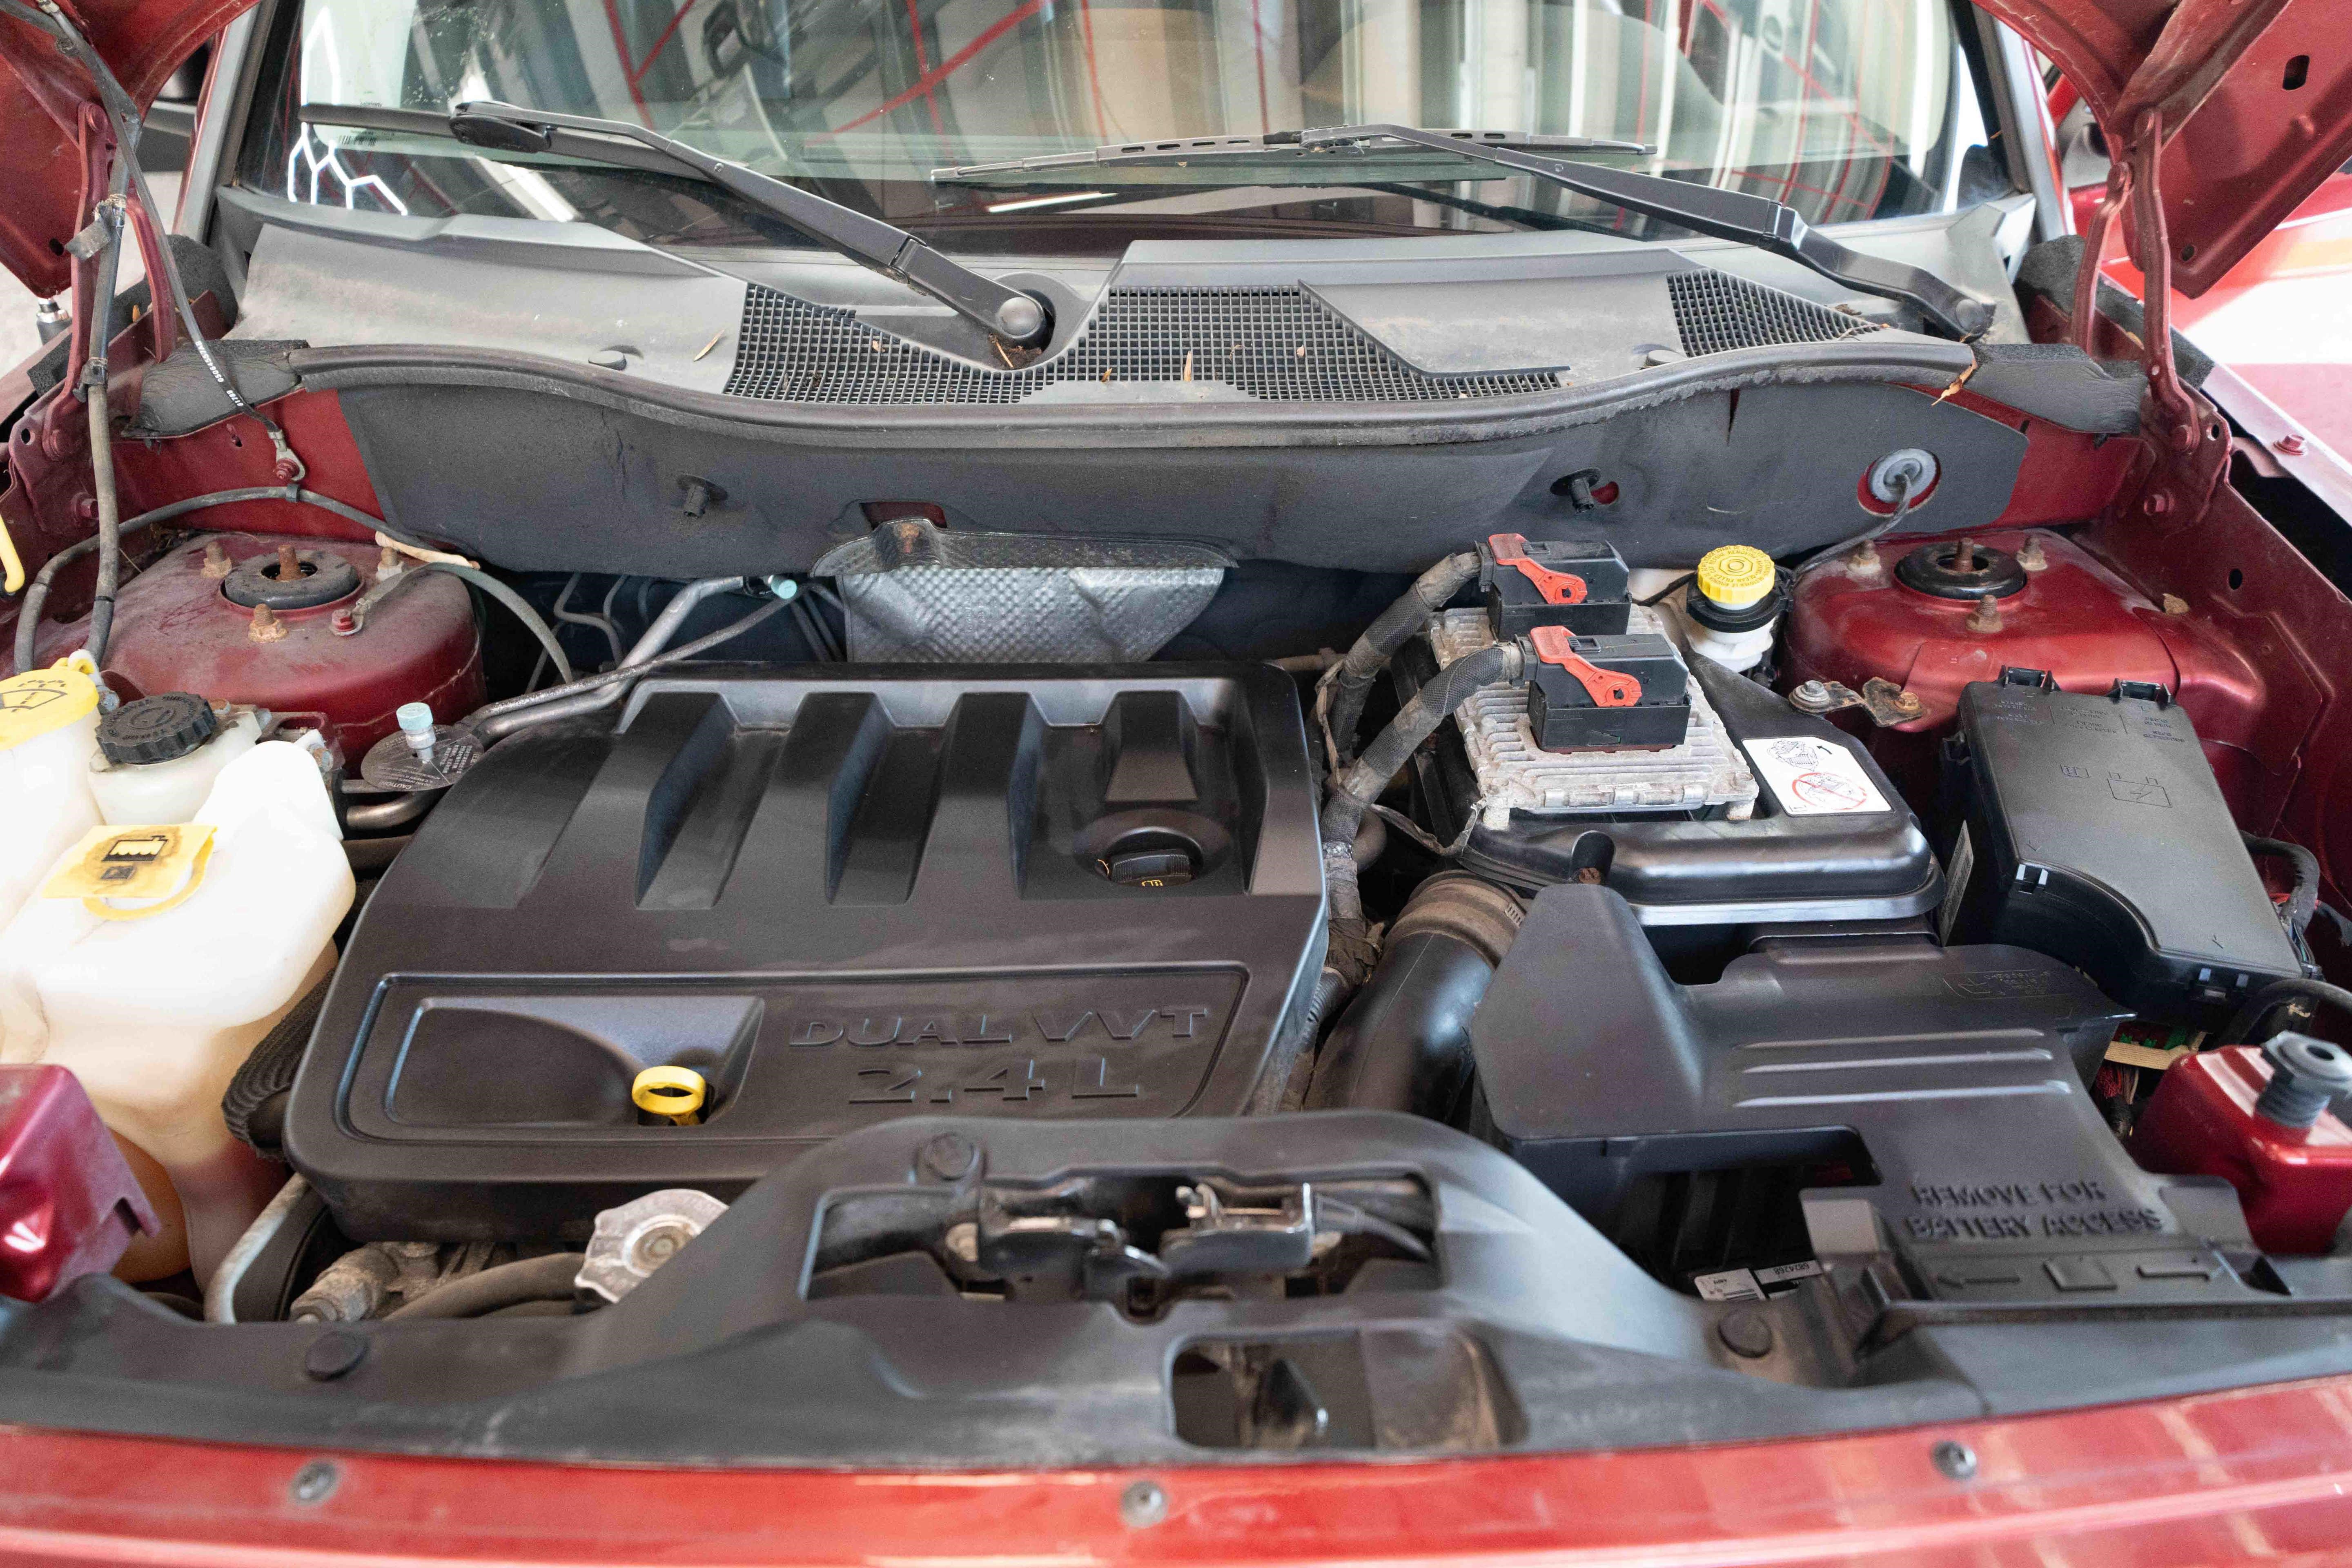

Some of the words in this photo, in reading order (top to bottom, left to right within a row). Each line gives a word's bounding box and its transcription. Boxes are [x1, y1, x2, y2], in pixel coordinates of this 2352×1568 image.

[788, 1010, 1013, 1048] DUAL
[1033, 1006, 1208, 1042] VVT
[1911, 1182, 2036, 1207] REMOVE
[2040, 1180, 2107, 1202] FOR
[1904, 1214, 2032, 1238] BATTERY
[2042, 1208, 2163, 1237] ACCESS
